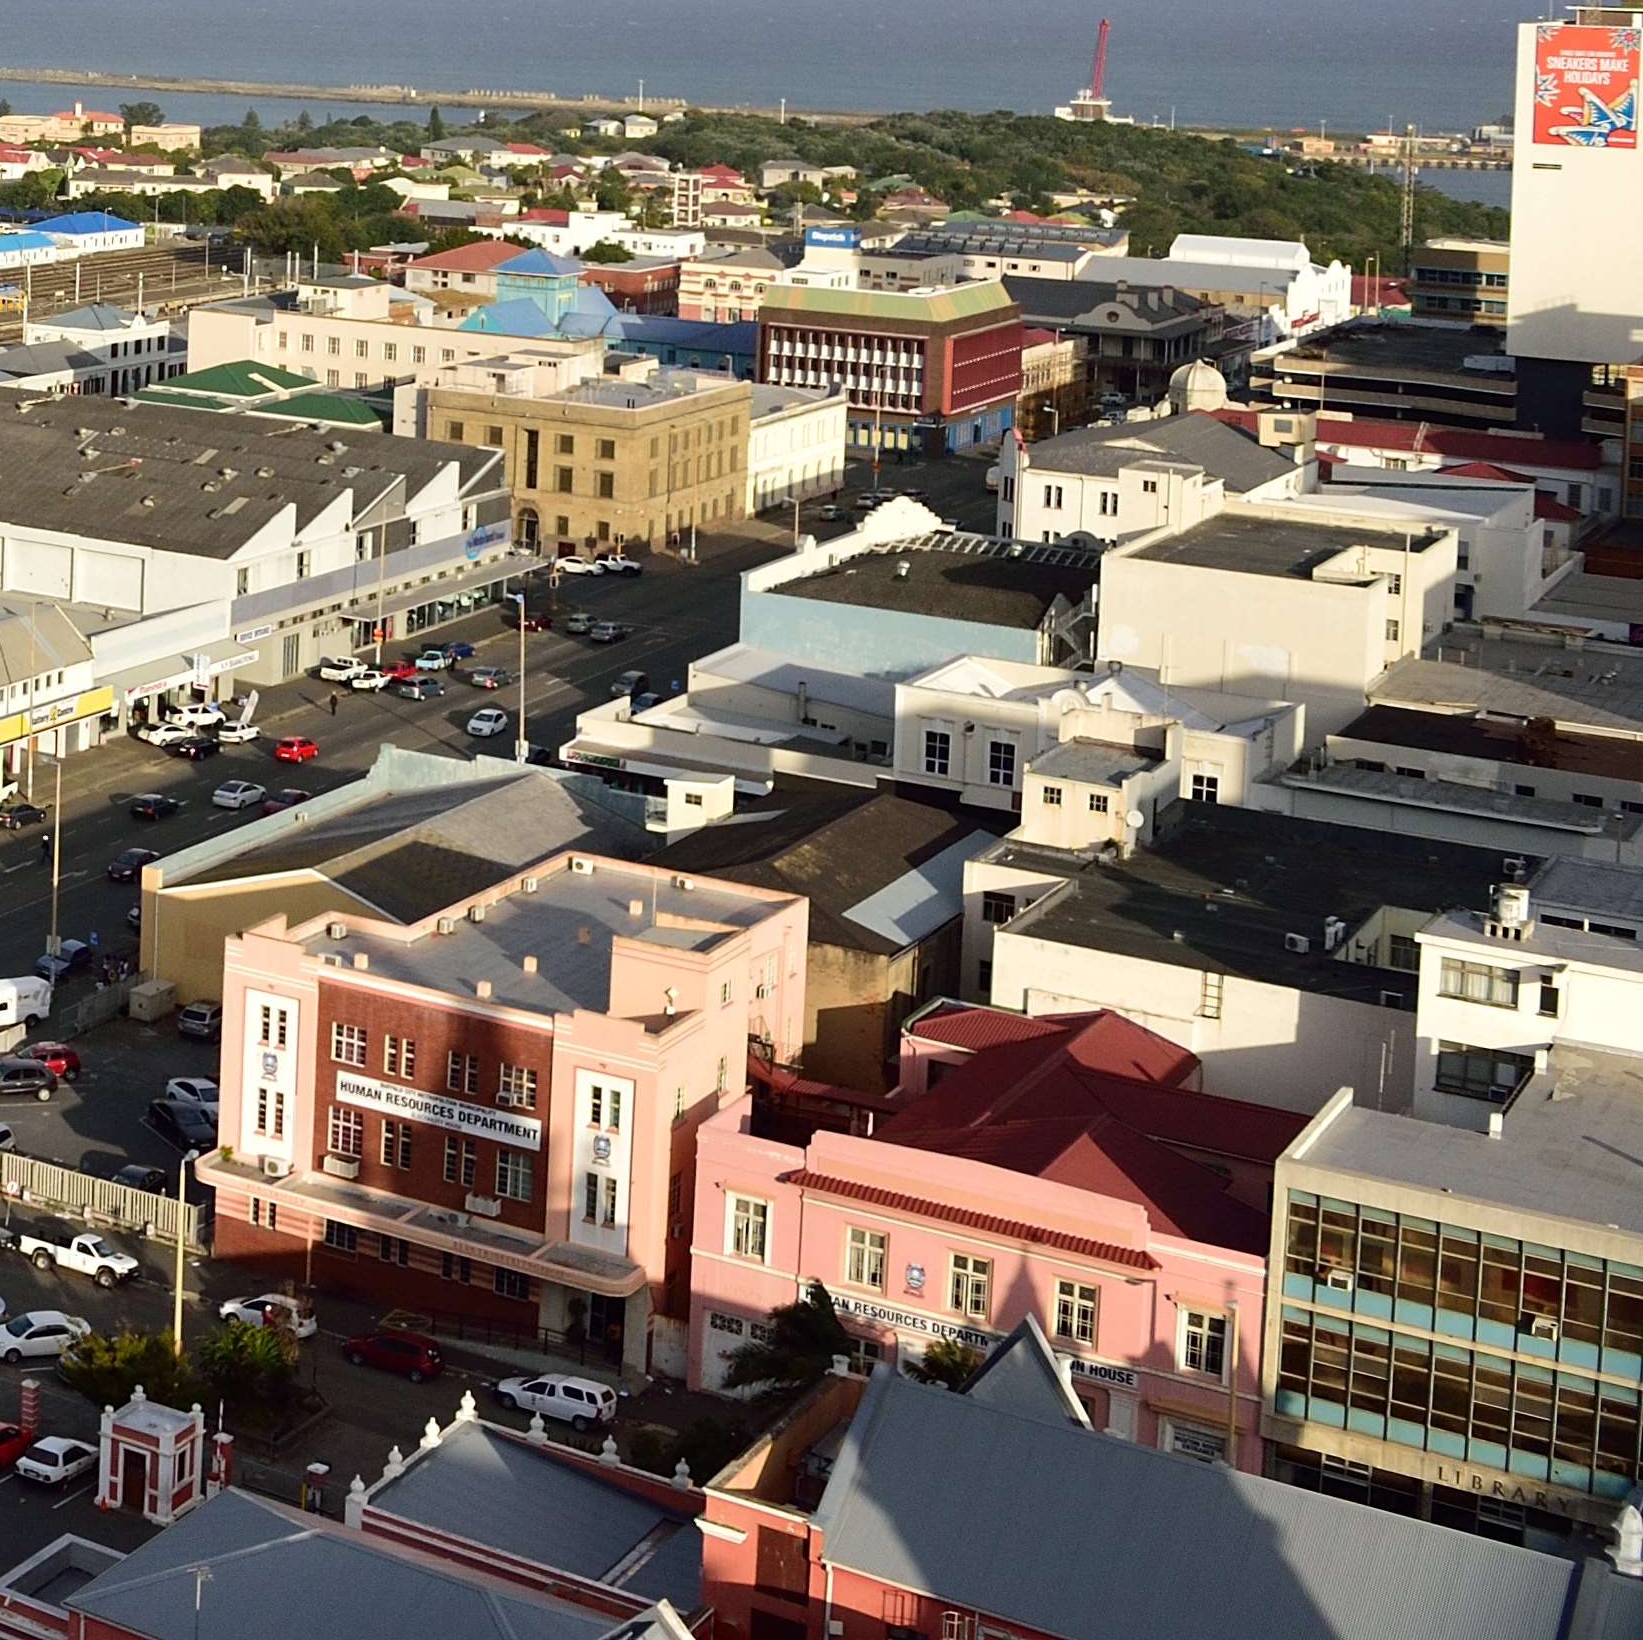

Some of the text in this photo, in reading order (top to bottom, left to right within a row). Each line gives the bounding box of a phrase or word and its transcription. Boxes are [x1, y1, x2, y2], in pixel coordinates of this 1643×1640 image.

[1547, 56, 1629, 72] SNEAKERS MAKE
[1564, 71, 1610, 84] HOLIDAYS
[340, 1080, 539, 1141] HUMAN RESOURCES DEPARTMENT
[805, 1288, 850, 1311] HAN
[854, 1302, 928, 1332] RESOURCES
[1089, 1364, 1134, 1386] HOUSE
[1438, 1466, 1572, 1510] LIBRARY
